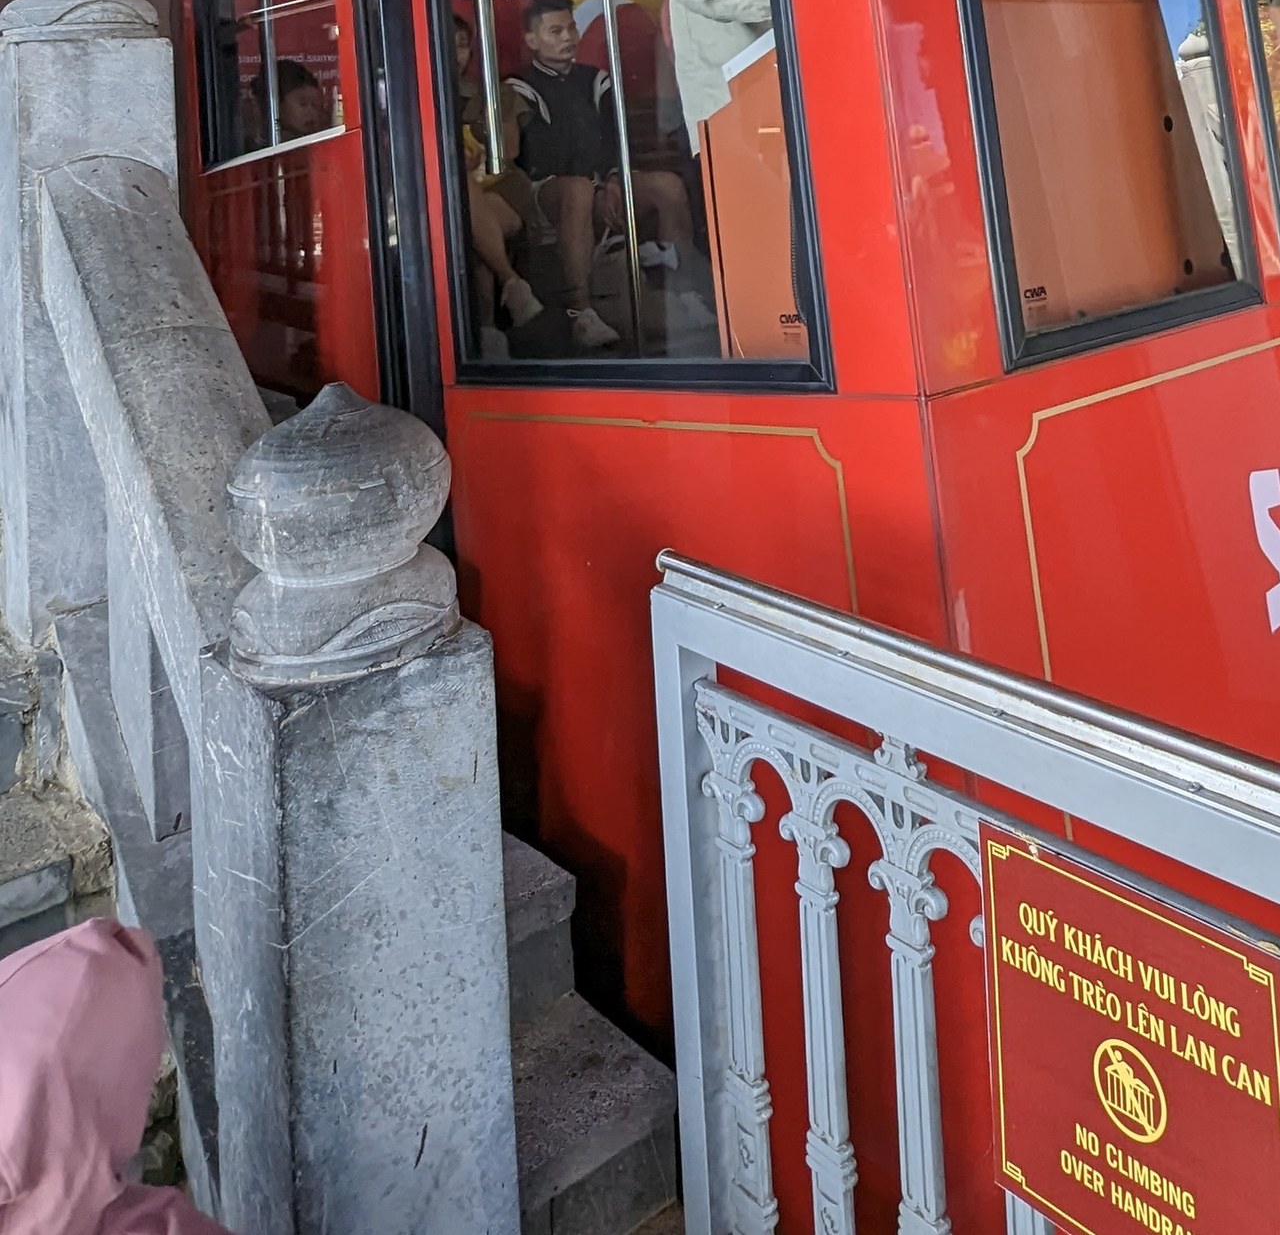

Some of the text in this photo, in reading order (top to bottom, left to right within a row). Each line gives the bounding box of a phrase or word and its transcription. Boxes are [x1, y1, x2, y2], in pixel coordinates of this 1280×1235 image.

[1001, 935, 1272, 1107] KHÔNG TRÈO LÊN LAN CAN
[1019, 902, 1241, 1038] QUÝ KHÁCH VUI LÒNG
[1060, 1149, 1105, 1198] OVER
[1075, 1122, 1196, 1220] NO CLIMBING
